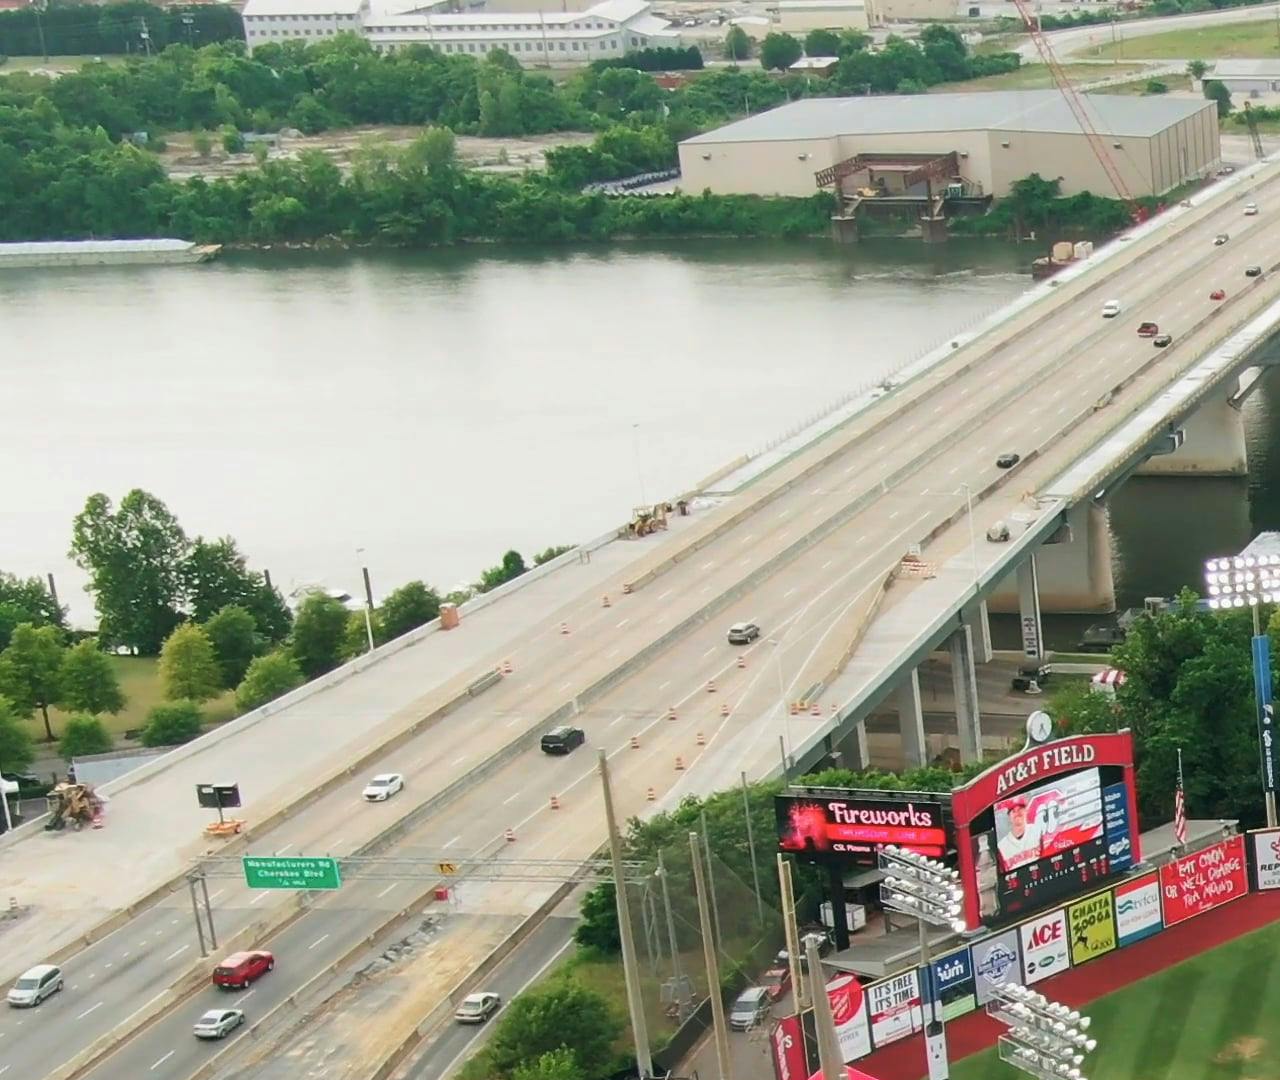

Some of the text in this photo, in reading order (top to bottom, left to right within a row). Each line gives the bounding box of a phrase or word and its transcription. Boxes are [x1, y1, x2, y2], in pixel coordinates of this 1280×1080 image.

[996, 744, 1095, 795] AT&T FIELD
[828, 802, 932, 827] Fireworks
[247, 860, 315, 868] Manufacturers
[257, 870, 324, 878] Cherokee Blvd
[1179, 860, 1196, 877] EAT
[1166, 884, 1178, 899] OR
[1072, 896, 1110, 919] CHATTA
[1027, 920, 1062, 951] ACE
[874, 973, 913, 999] IT'S FREE
[875, 996, 892, 1013] IT'S
[893, 987, 915, 1005] TIME
